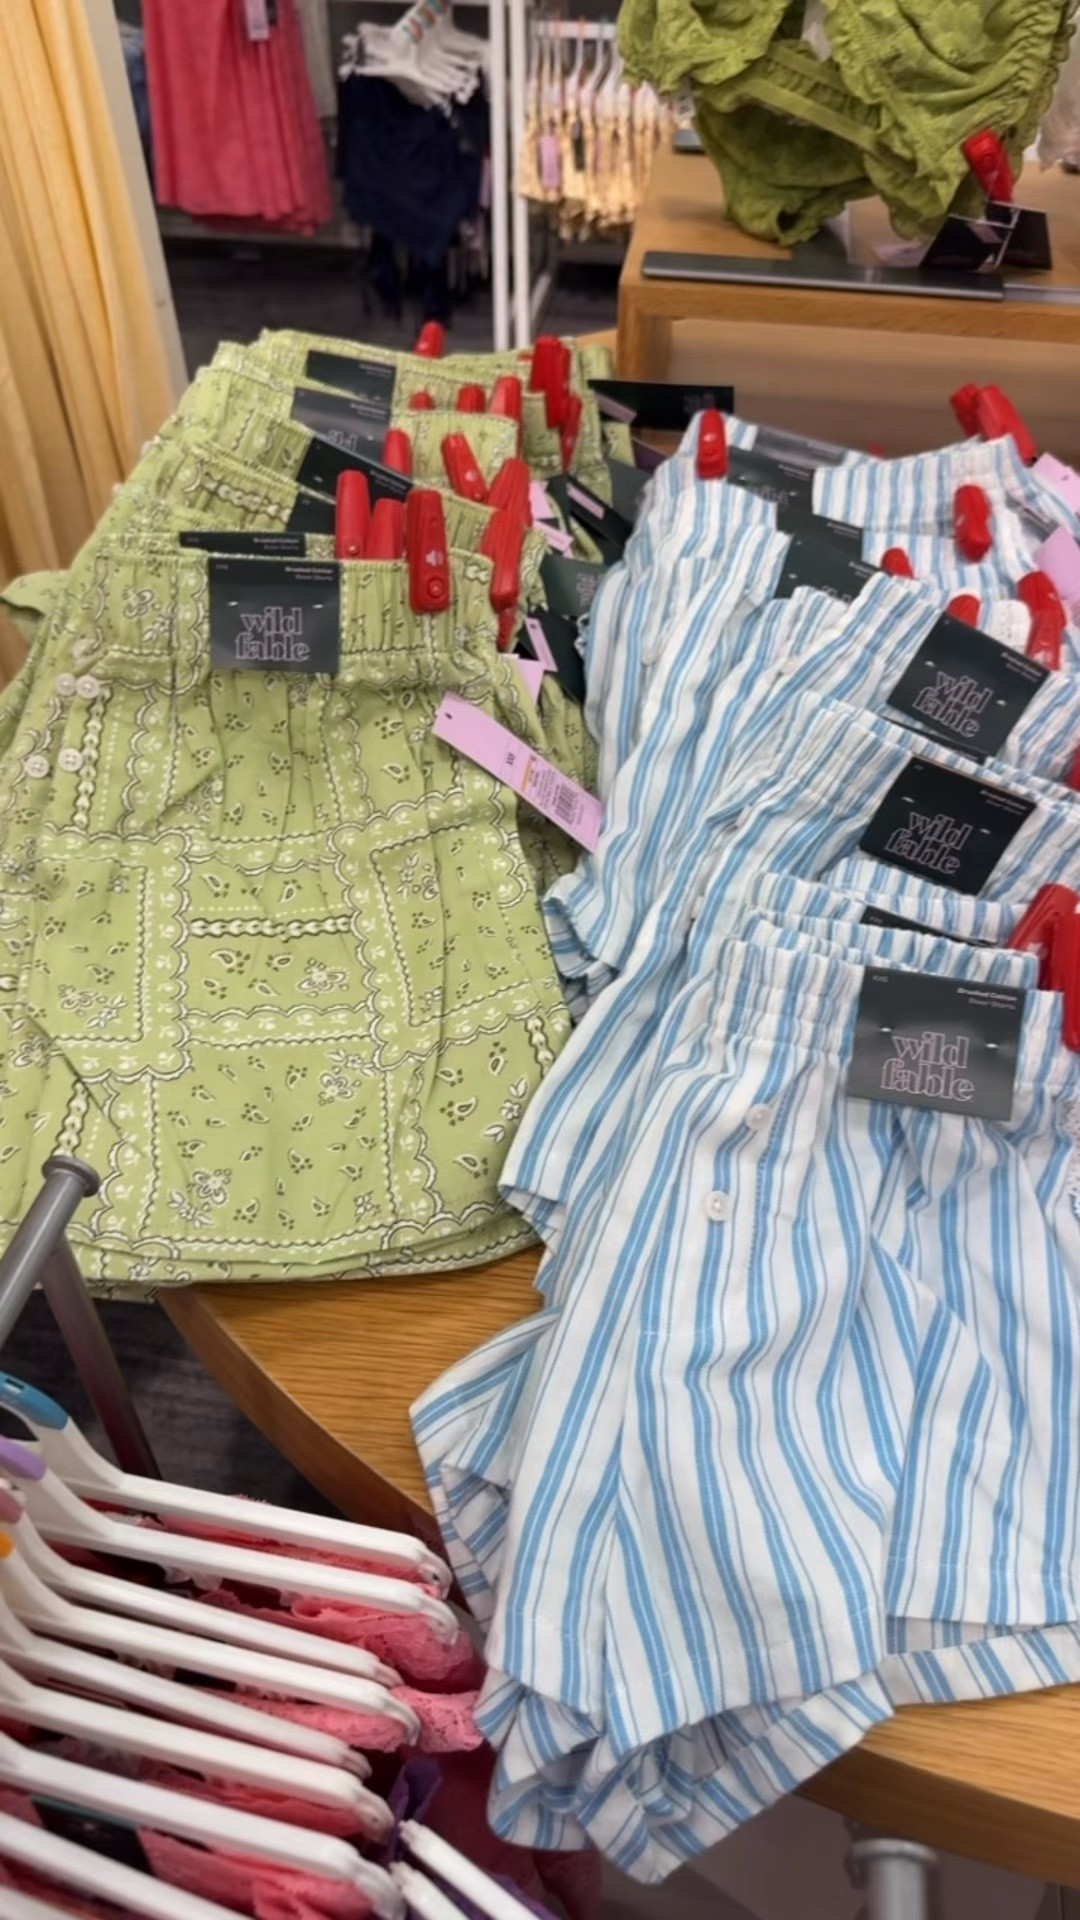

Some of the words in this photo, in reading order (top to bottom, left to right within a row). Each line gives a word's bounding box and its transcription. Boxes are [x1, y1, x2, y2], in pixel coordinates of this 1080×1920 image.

[240, 606, 302, 635] wild
[235, 632, 311, 662] fable
[912, 686, 980, 737] fable
[936, 671, 993, 713] wild
[884, 828, 960, 874] fable
[909, 812, 973, 850] wild
[892, 1031, 970, 1068] wild
[880, 1058, 975, 1101] fable
